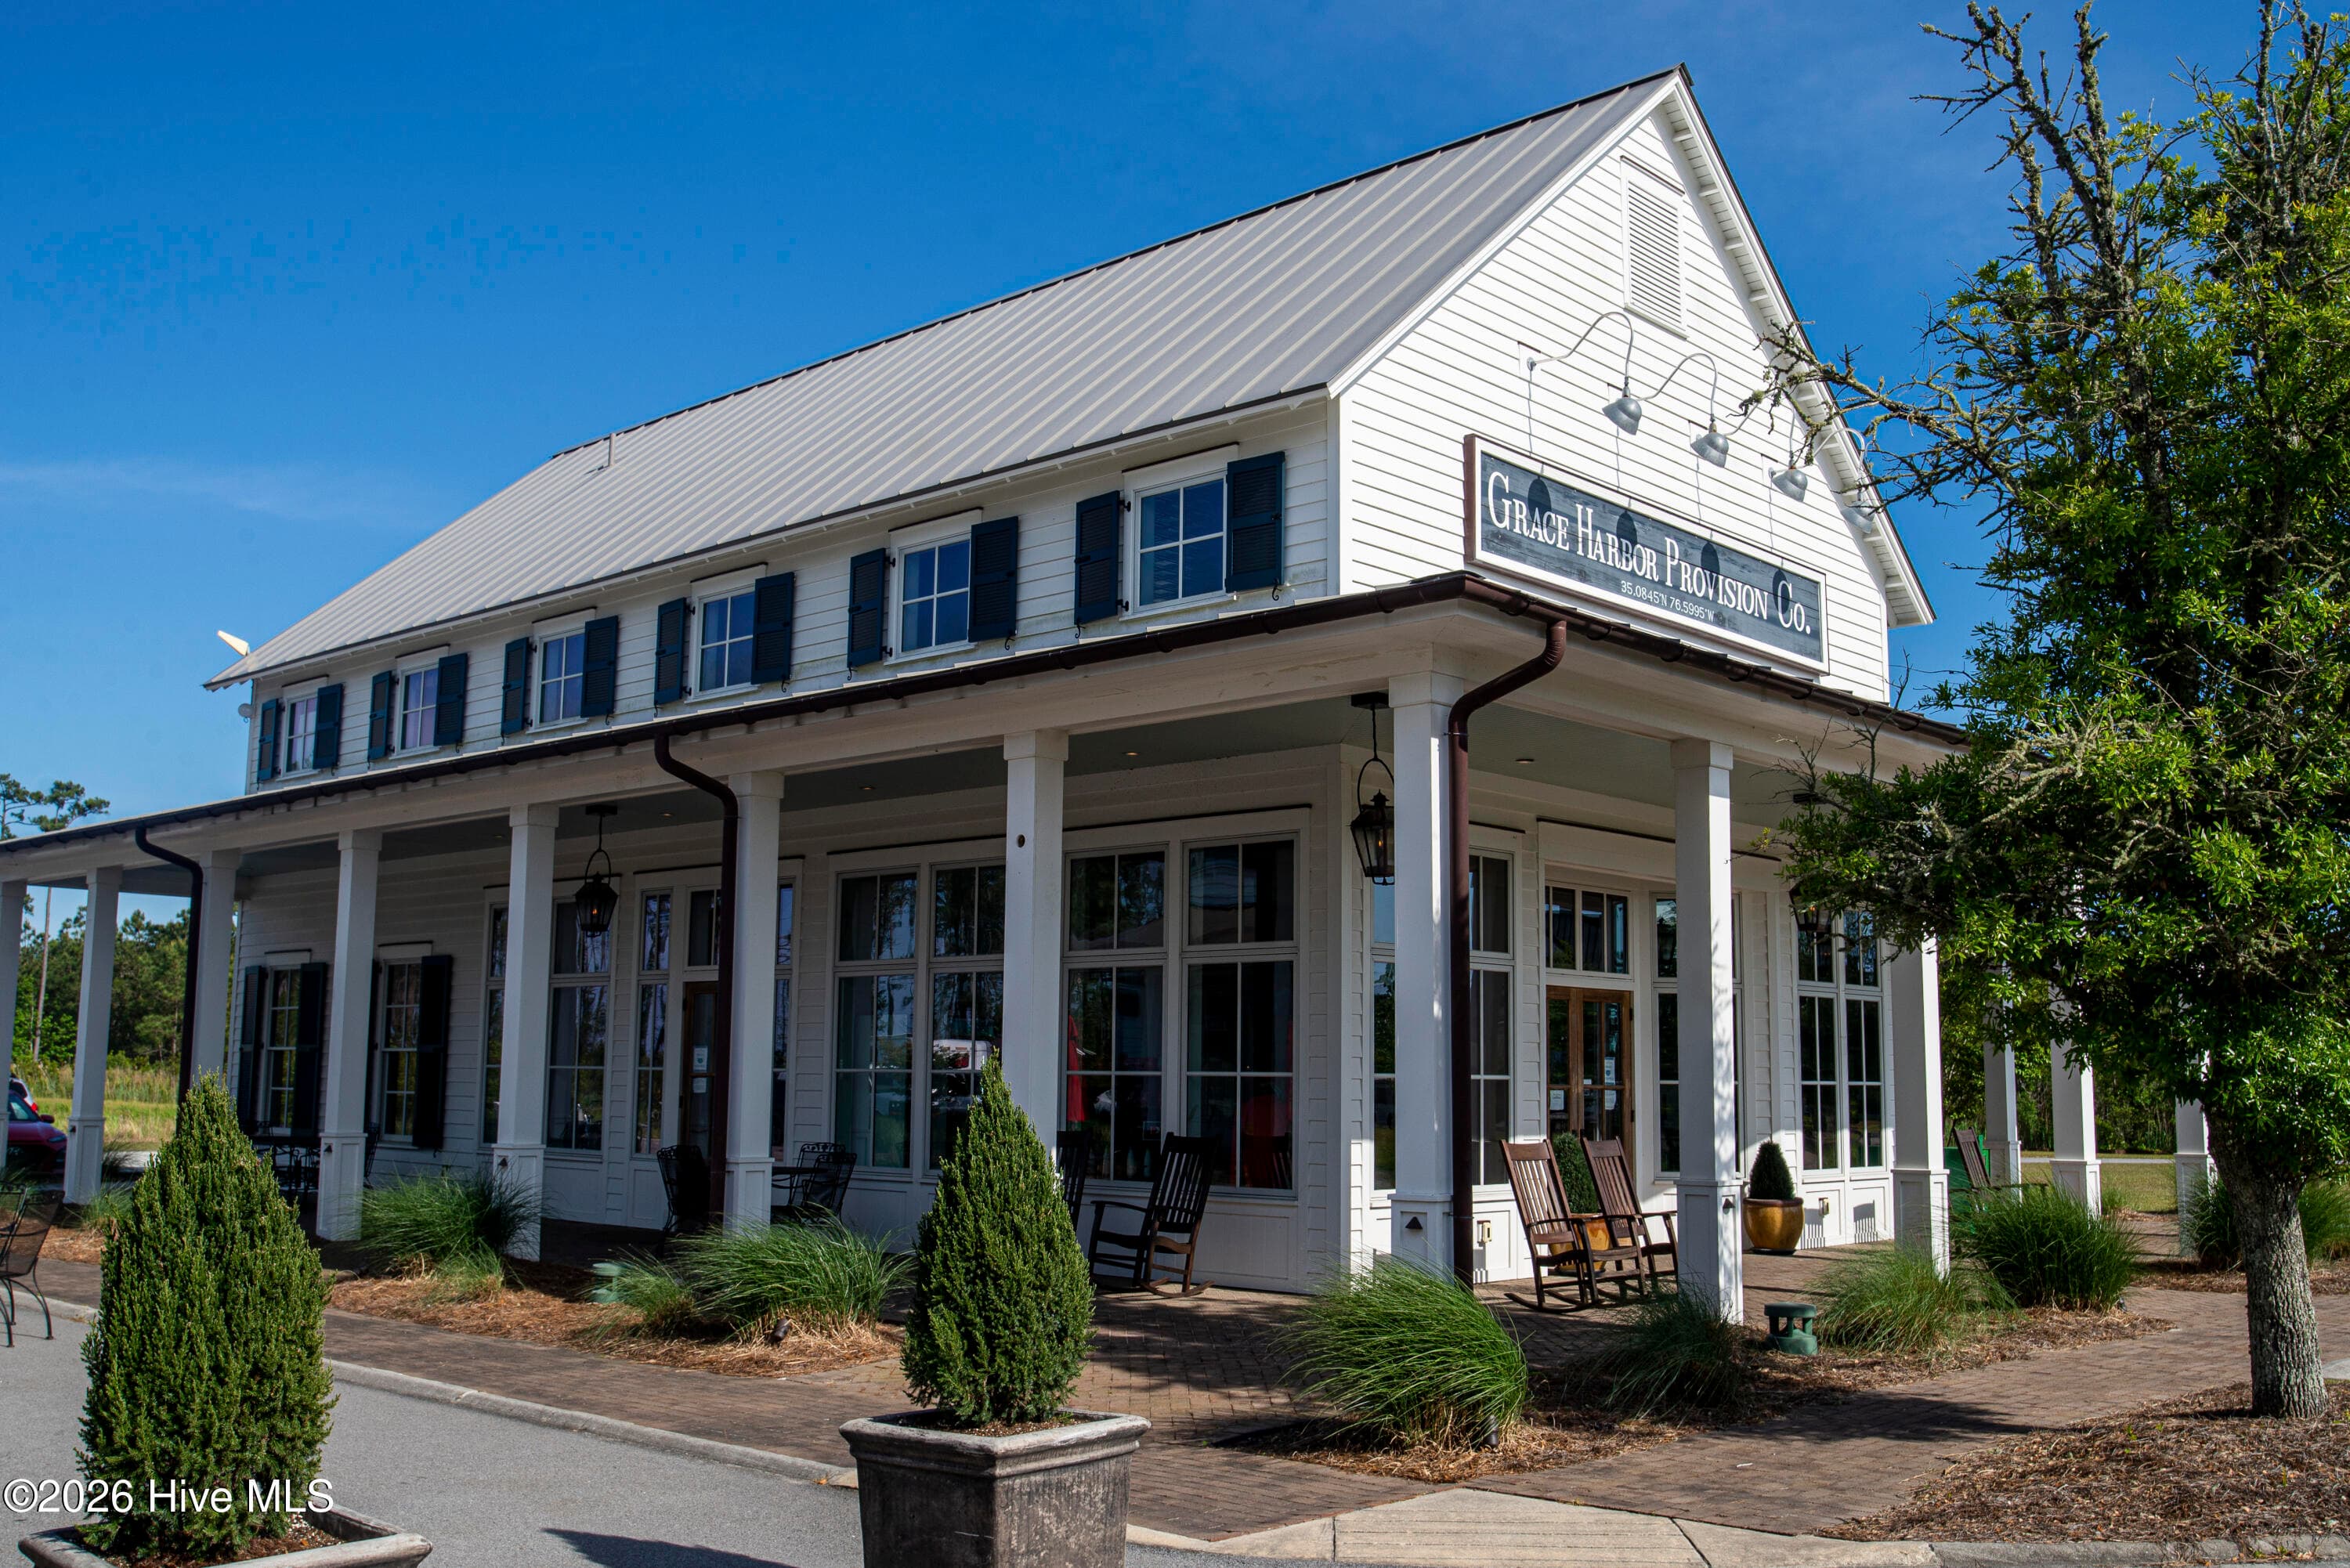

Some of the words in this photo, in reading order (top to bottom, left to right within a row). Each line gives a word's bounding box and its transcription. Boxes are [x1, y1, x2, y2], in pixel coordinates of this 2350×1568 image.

[1488, 471, 1570, 551] GRACE
[1575, 503, 1660, 583] HARBOR
[1664, 537, 1770, 621] PROVISION
